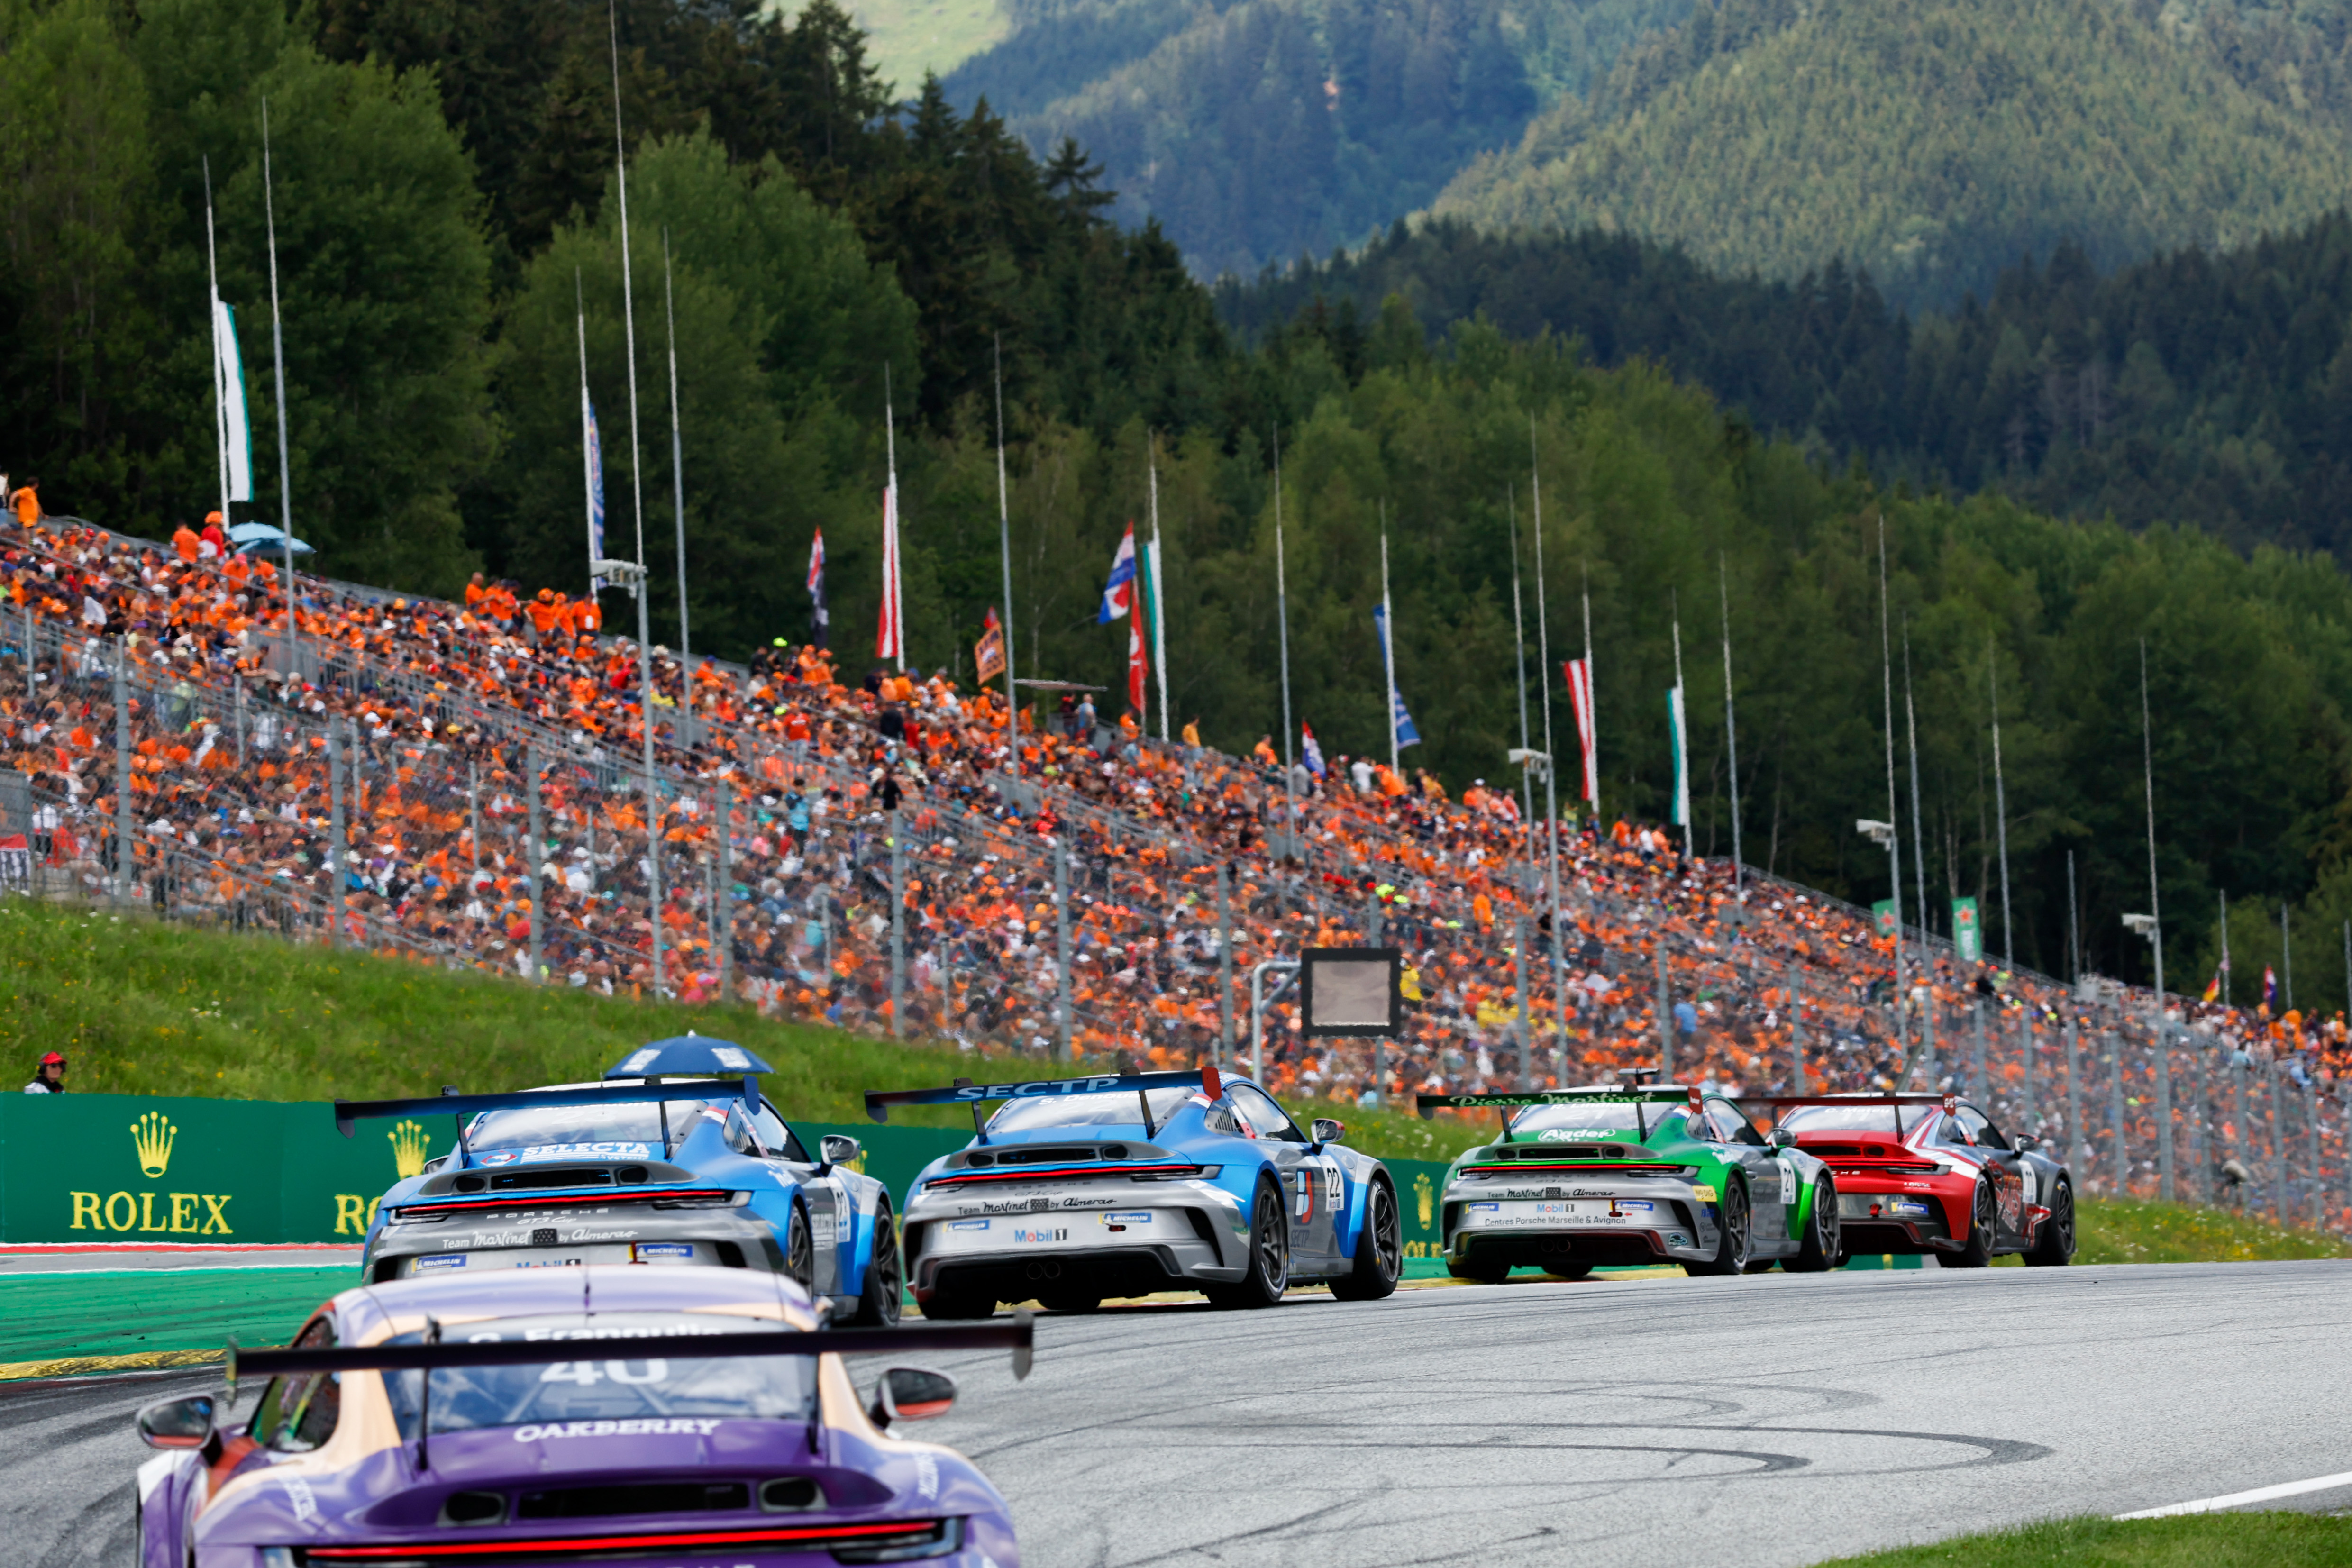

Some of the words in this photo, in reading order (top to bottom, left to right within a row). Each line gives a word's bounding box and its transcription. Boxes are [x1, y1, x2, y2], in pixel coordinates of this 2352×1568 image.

[955, 1078, 1119, 1100] SECTP
[1063, 1093, 1148, 1101] Denoua
[1450, 1095, 1532, 1106] Pierre
[1540, 1092, 1656, 1104] Martinet
[522, 1142, 651, 1156] SELECTA
[1327, 1167, 1340, 1198] 22
[1508, 1187, 1544, 1199] Martinet
[69, 1190, 233, 1235] ROLEX
[487, 1208, 609, 1219] PORSCHE
[958, 1206, 980, 1215] Team
[982, 1201, 1030, 1214] Martinet
[1050, 1201, 1060, 1210] by
[1536, 1204, 1563, 1213] Mobil
[551, 1216, 577, 1224] Cup
[1485, 1218, 1514, 1226] Centres
[1515, 1217, 1547, 1225] Porsche
[1548, 1216, 1584, 1224] Marseille
[1594, 1216, 1626, 1225] Avignon
[443, 1238, 470, 1249] Team
[472, 1230, 533, 1247] Martinet
[559, 1233, 570, 1243] by
[571, 1228, 638, 1240] Almeras
[1014, 1229, 1053, 1243] Mobil
[647, 1247, 688, 1255] MICHELIN
[423, 1258, 461, 1267] MICHELIN
[539, 1358, 669, 1386] 40
[513, 1419, 723, 1442] OAKBERRY
